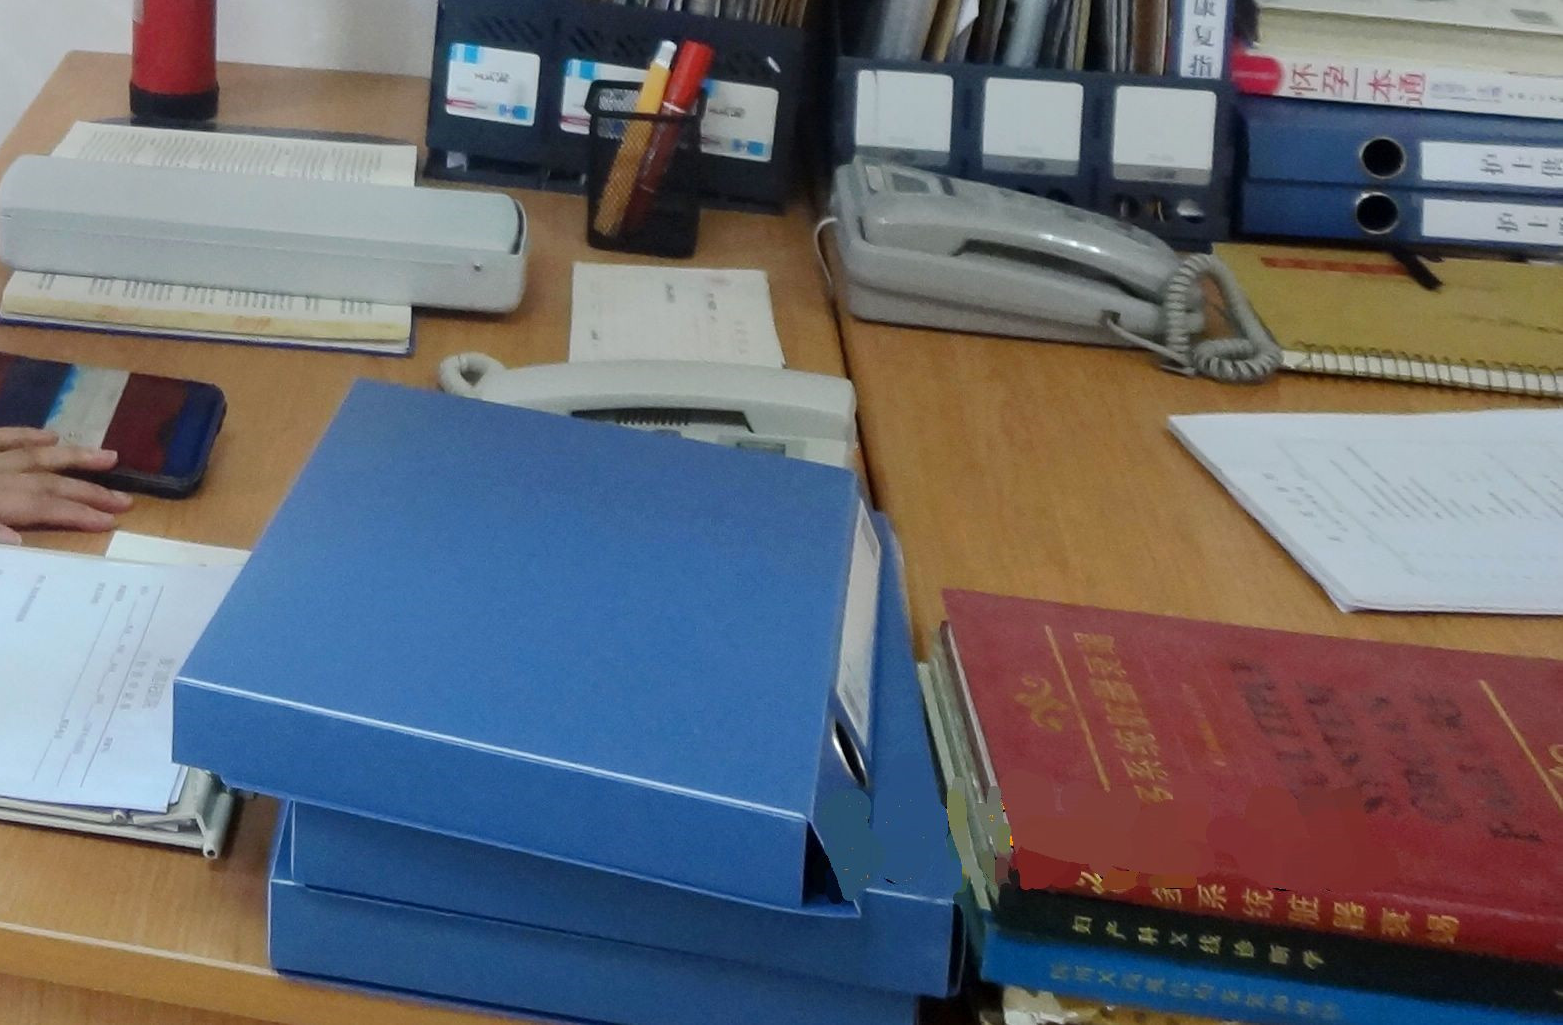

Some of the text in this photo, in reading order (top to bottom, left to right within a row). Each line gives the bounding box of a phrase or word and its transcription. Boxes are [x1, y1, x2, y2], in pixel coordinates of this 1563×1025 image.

[1289, 63, 1426, 105] 怀孕一本通
